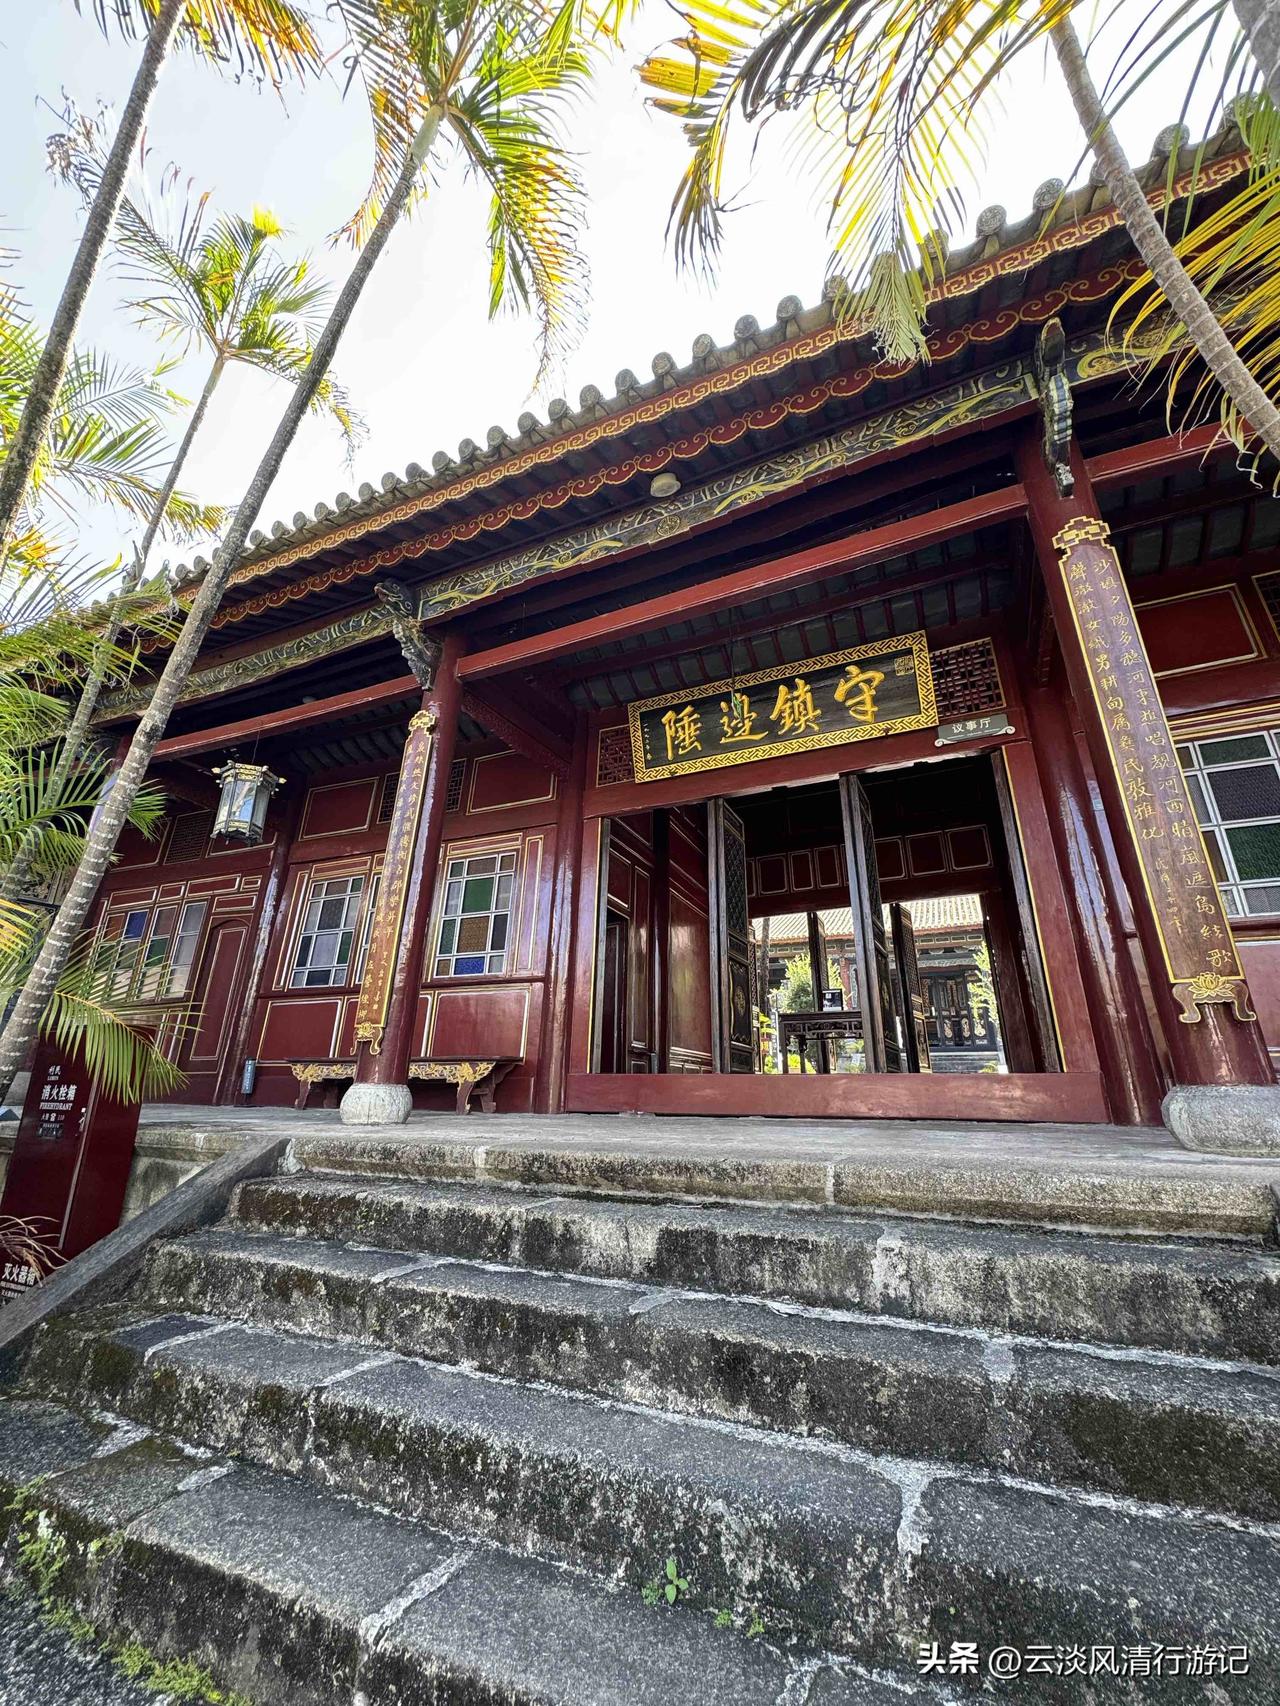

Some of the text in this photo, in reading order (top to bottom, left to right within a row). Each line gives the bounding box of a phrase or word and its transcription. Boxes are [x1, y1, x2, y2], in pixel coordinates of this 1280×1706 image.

[951, 717, 991, 734] 议事厅
[41, 1084, 77, 1101] 消火栓箱
[1, 1262, 36, 1286] 灭火器箱
